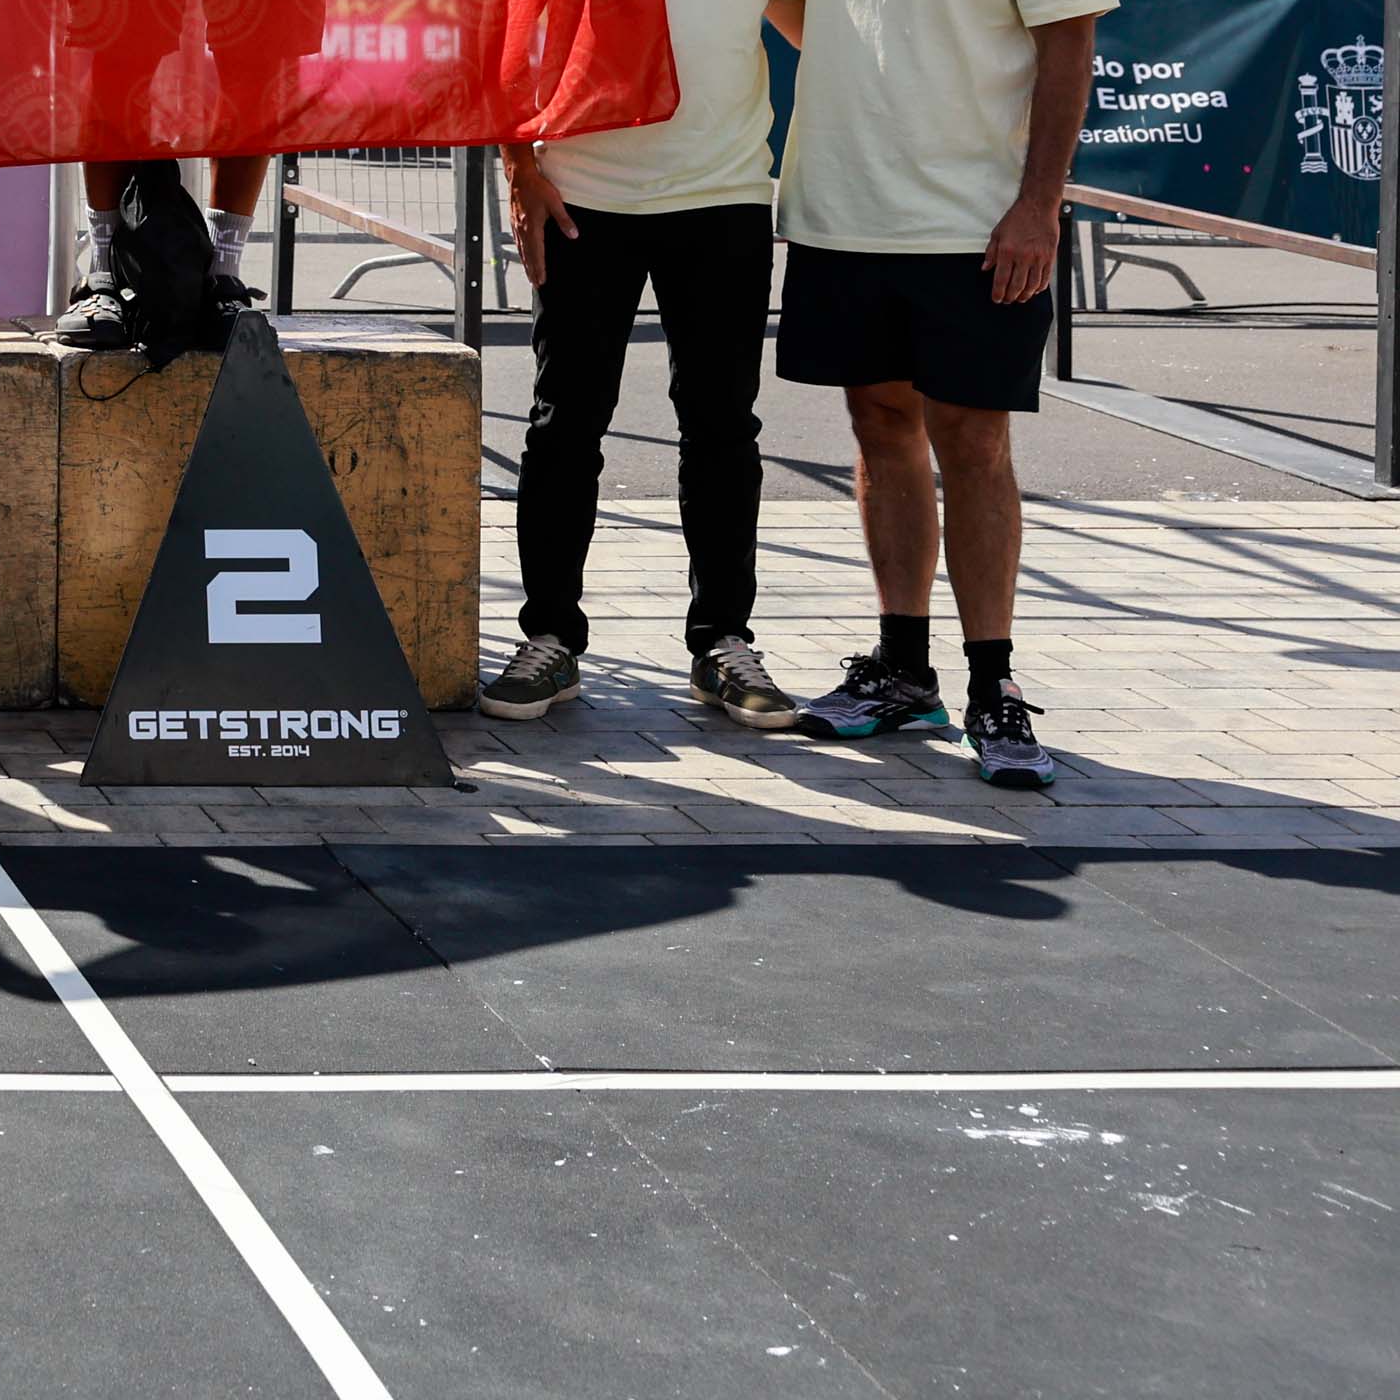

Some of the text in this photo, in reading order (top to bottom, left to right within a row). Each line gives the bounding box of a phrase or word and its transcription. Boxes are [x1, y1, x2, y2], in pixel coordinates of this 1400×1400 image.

[1132, 60, 1185, 84] por
[1096, 87, 1228, 113] Europea
[204, 529, 322, 643] 2
[228, 745, 310, 757] EST. 2014
